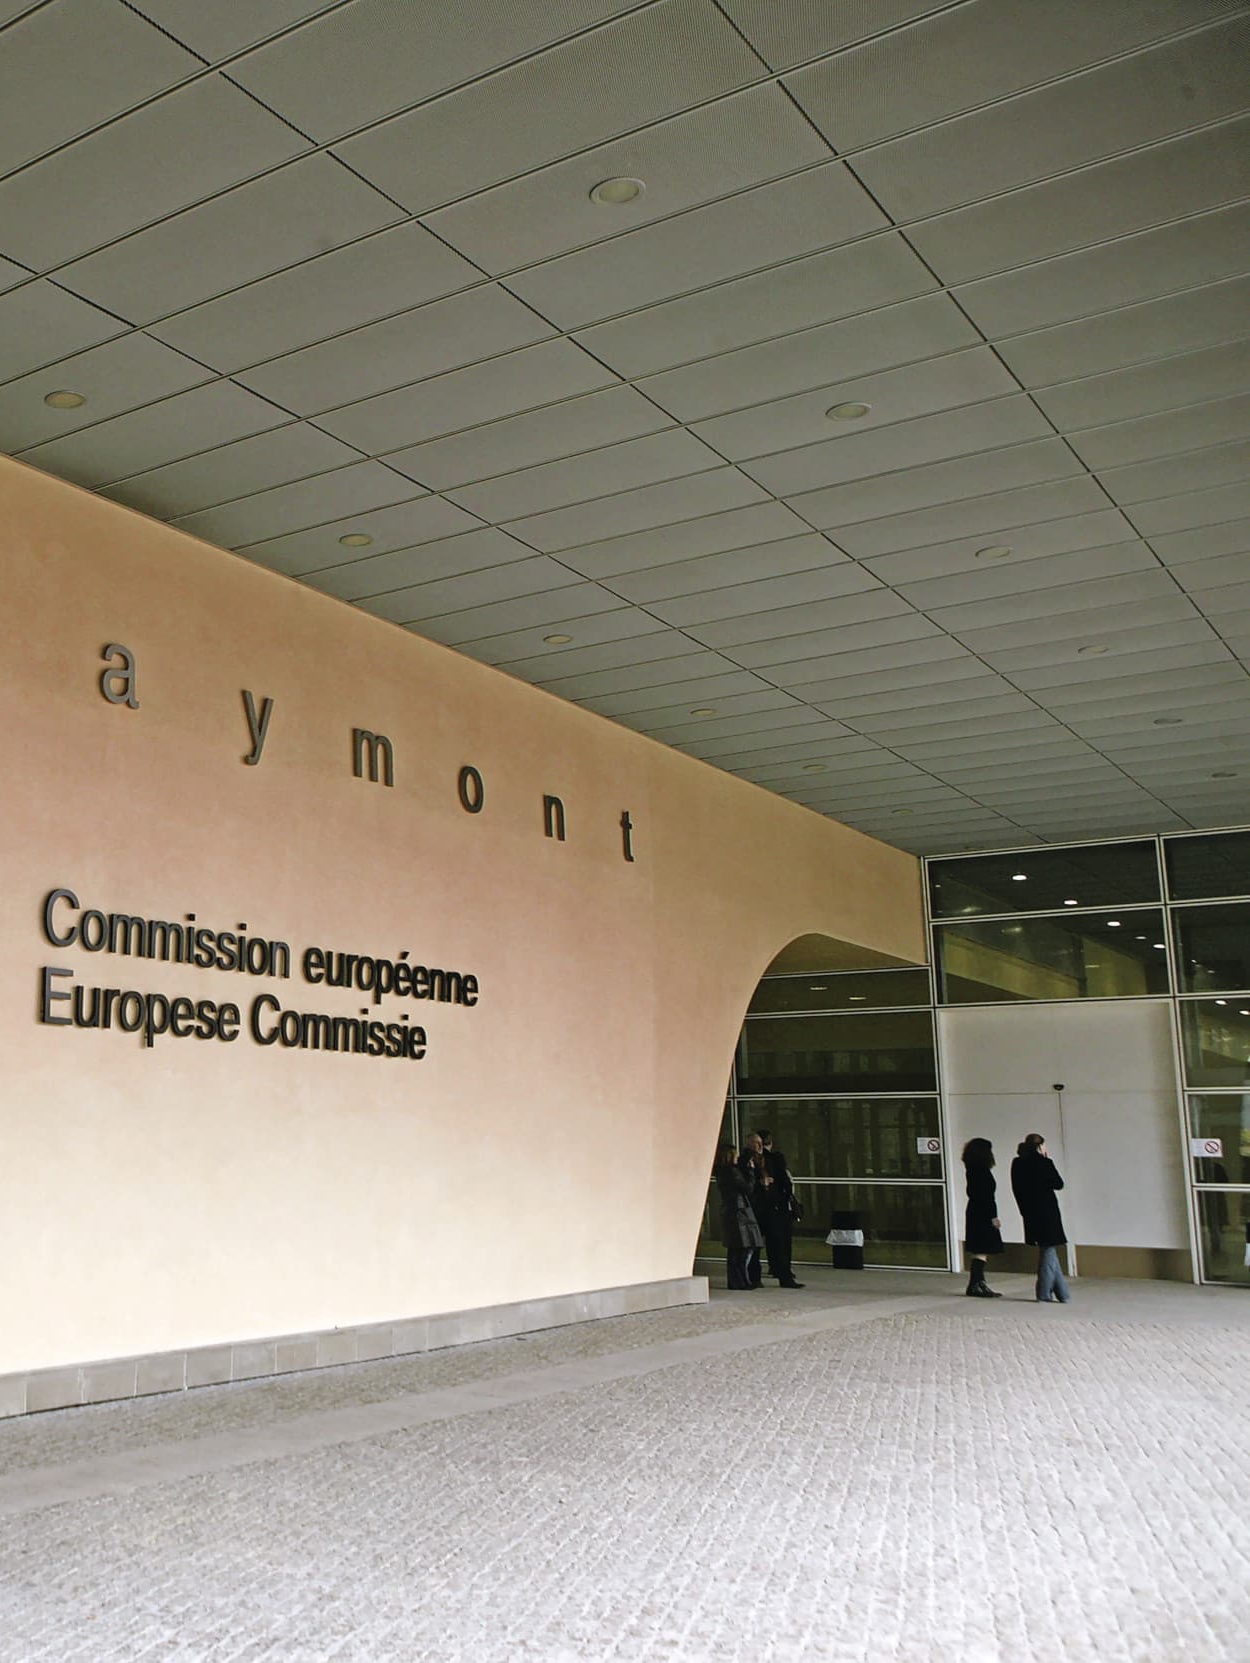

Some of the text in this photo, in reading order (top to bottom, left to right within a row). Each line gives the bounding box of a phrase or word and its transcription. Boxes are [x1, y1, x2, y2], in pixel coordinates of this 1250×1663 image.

[43, 888, 479, 1007] Commission européenne
[40, 966, 427, 1060] Europese Commissie
